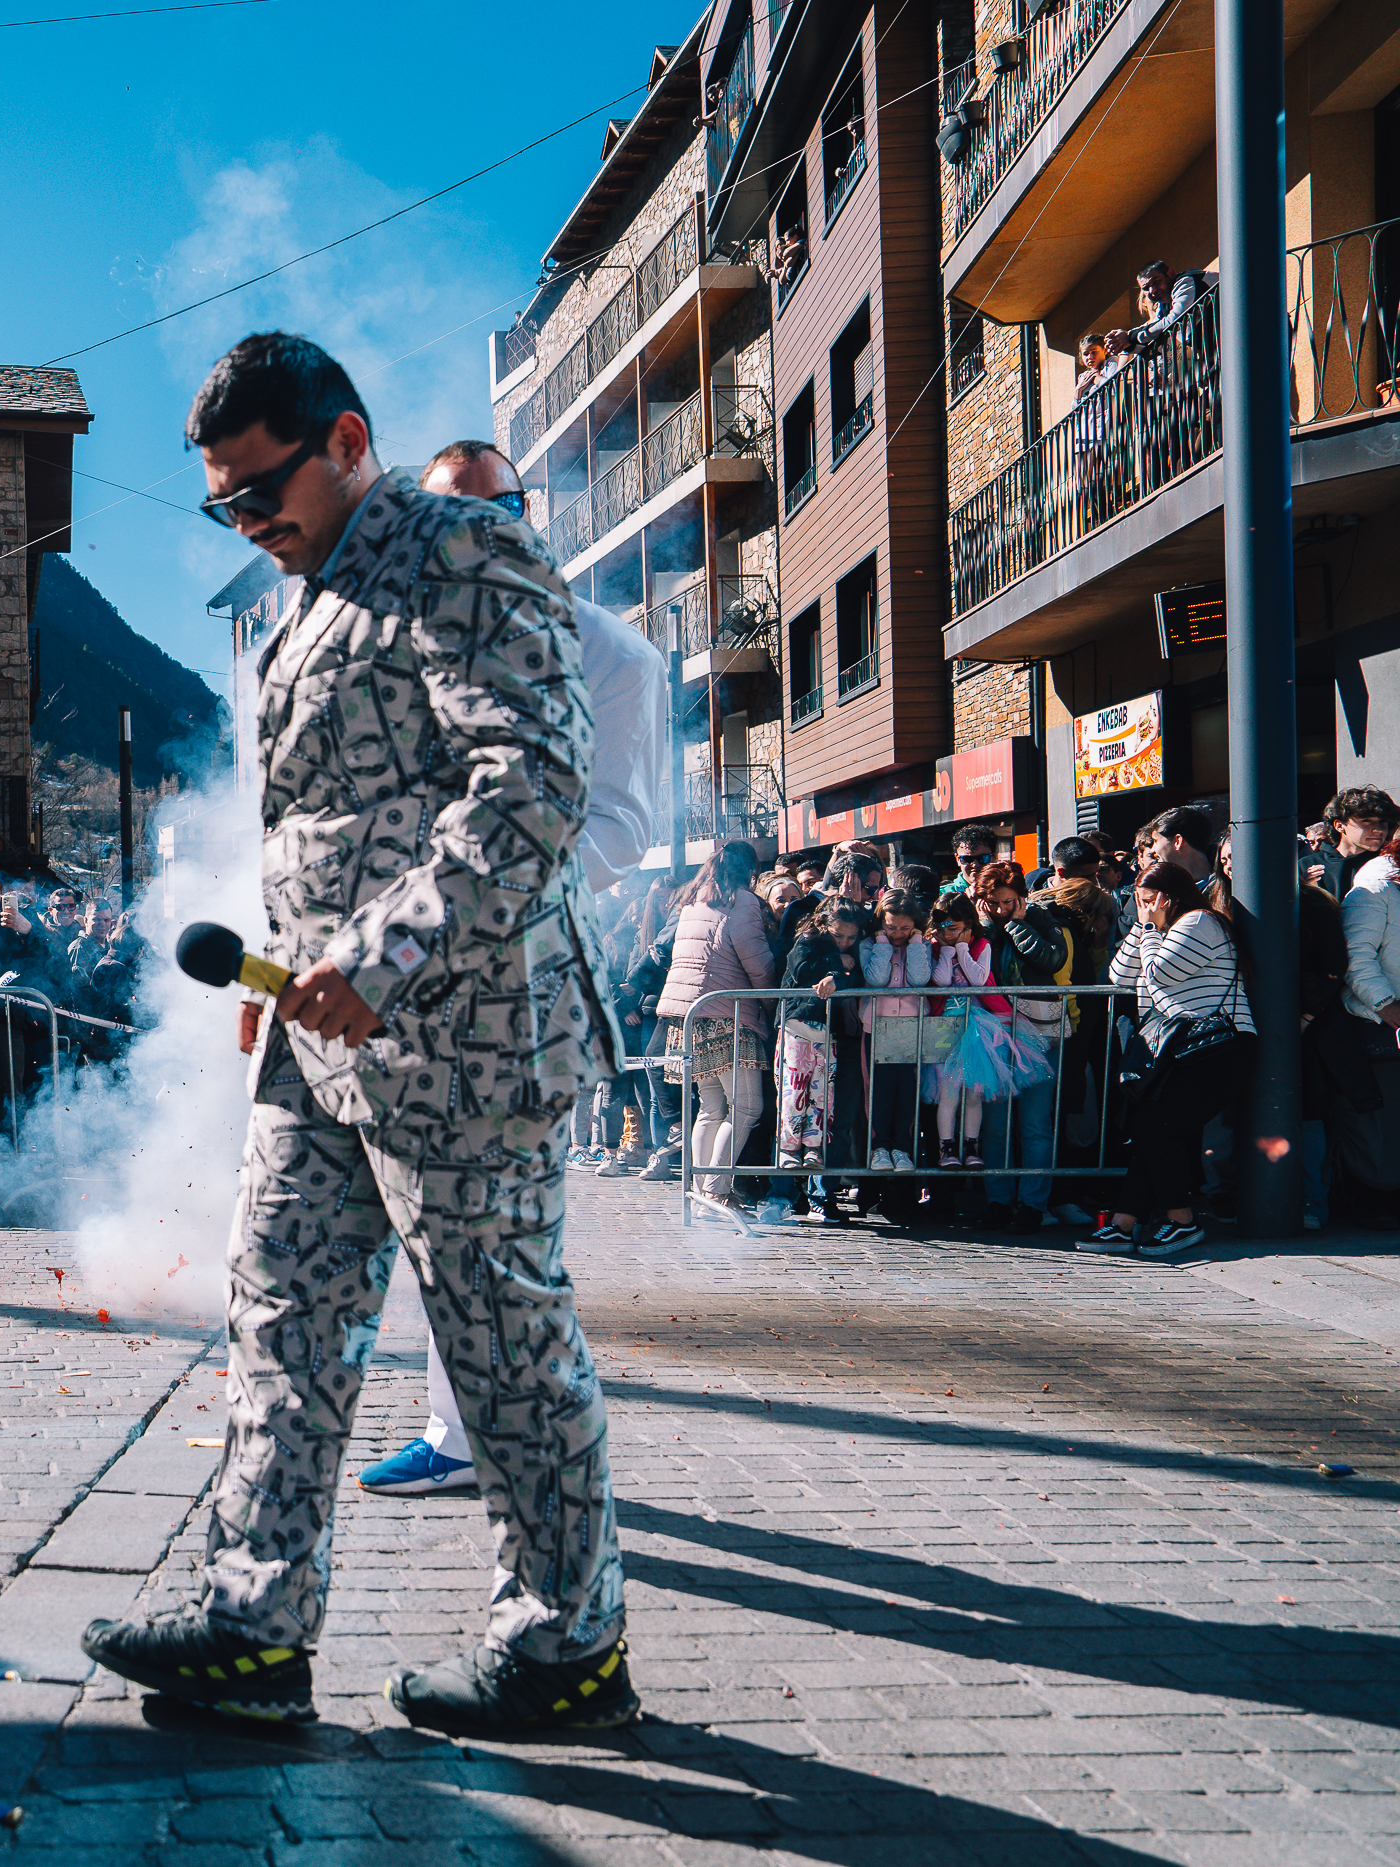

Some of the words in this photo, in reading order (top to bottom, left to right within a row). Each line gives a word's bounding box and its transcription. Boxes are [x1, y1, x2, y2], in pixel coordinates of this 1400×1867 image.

[1097, 705, 1128, 733] ENKEBAB
[1098, 741, 1127, 763] PIZZERIA
[965, 768, 1003, 793] Supermercats
[935, 1024, 952, 1049] 2
